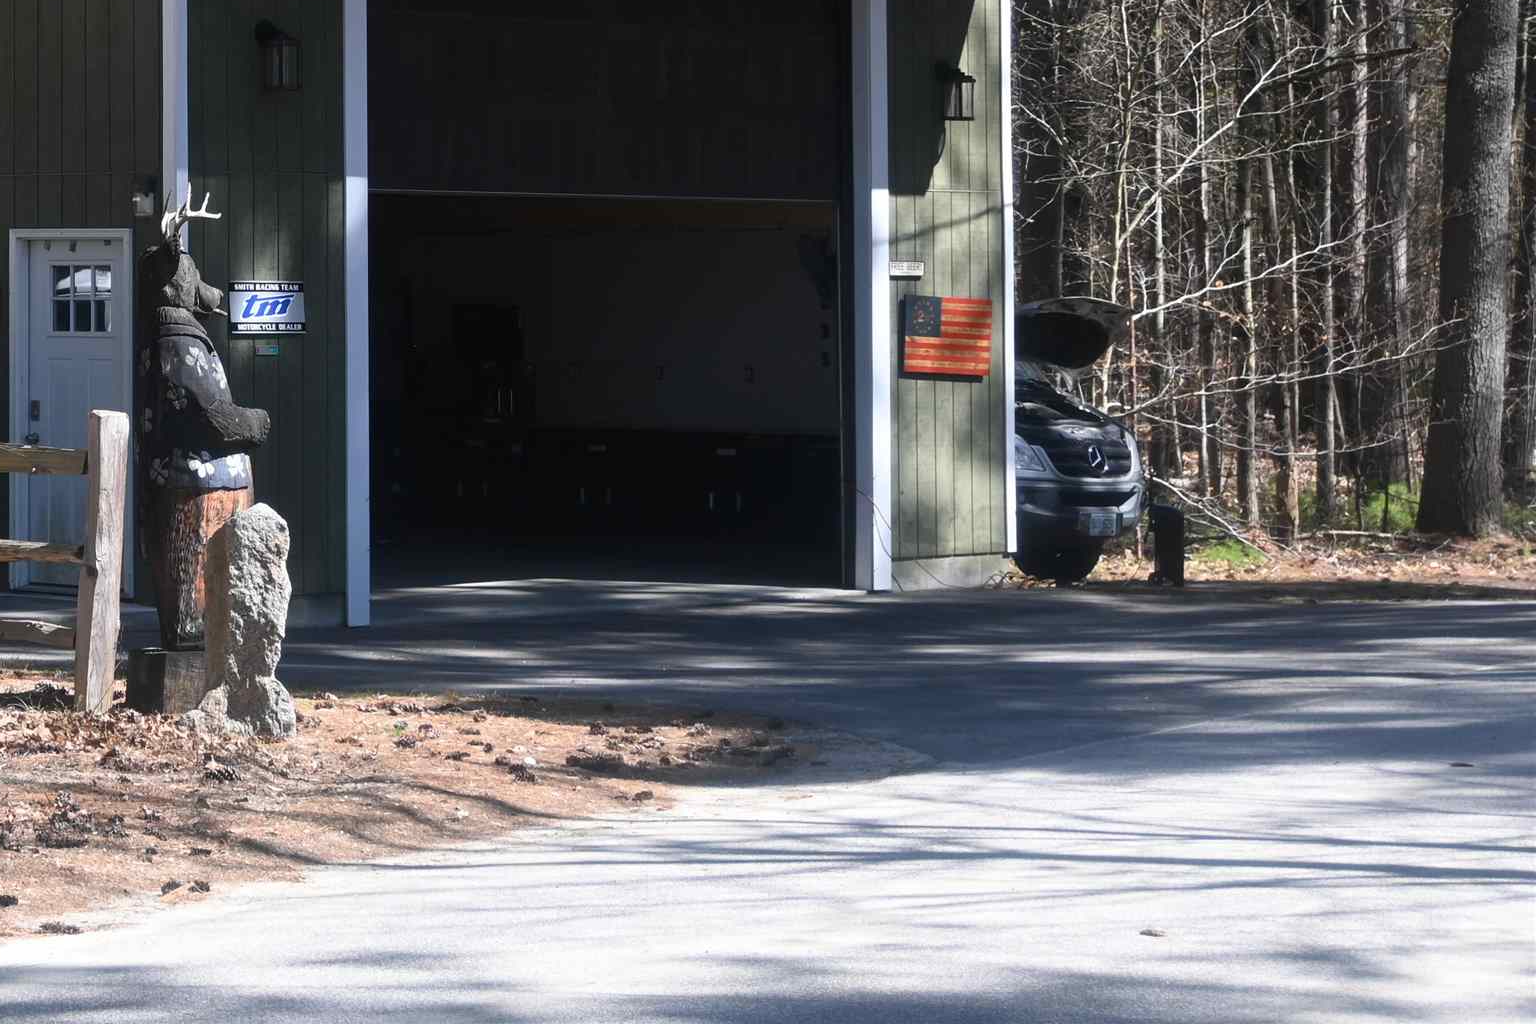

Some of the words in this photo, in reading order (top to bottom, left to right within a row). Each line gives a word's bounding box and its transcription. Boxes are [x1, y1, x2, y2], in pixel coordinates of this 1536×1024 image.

[234, 283, 254, 291] SMITH
[255, 283, 280, 291] RACING
[281, 283, 299, 291] TEAM
[242, 294, 295, 318] tm
[237, 323, 276, 331] MOTORCYCLE
[278, 323, 302, 331] DEALER
